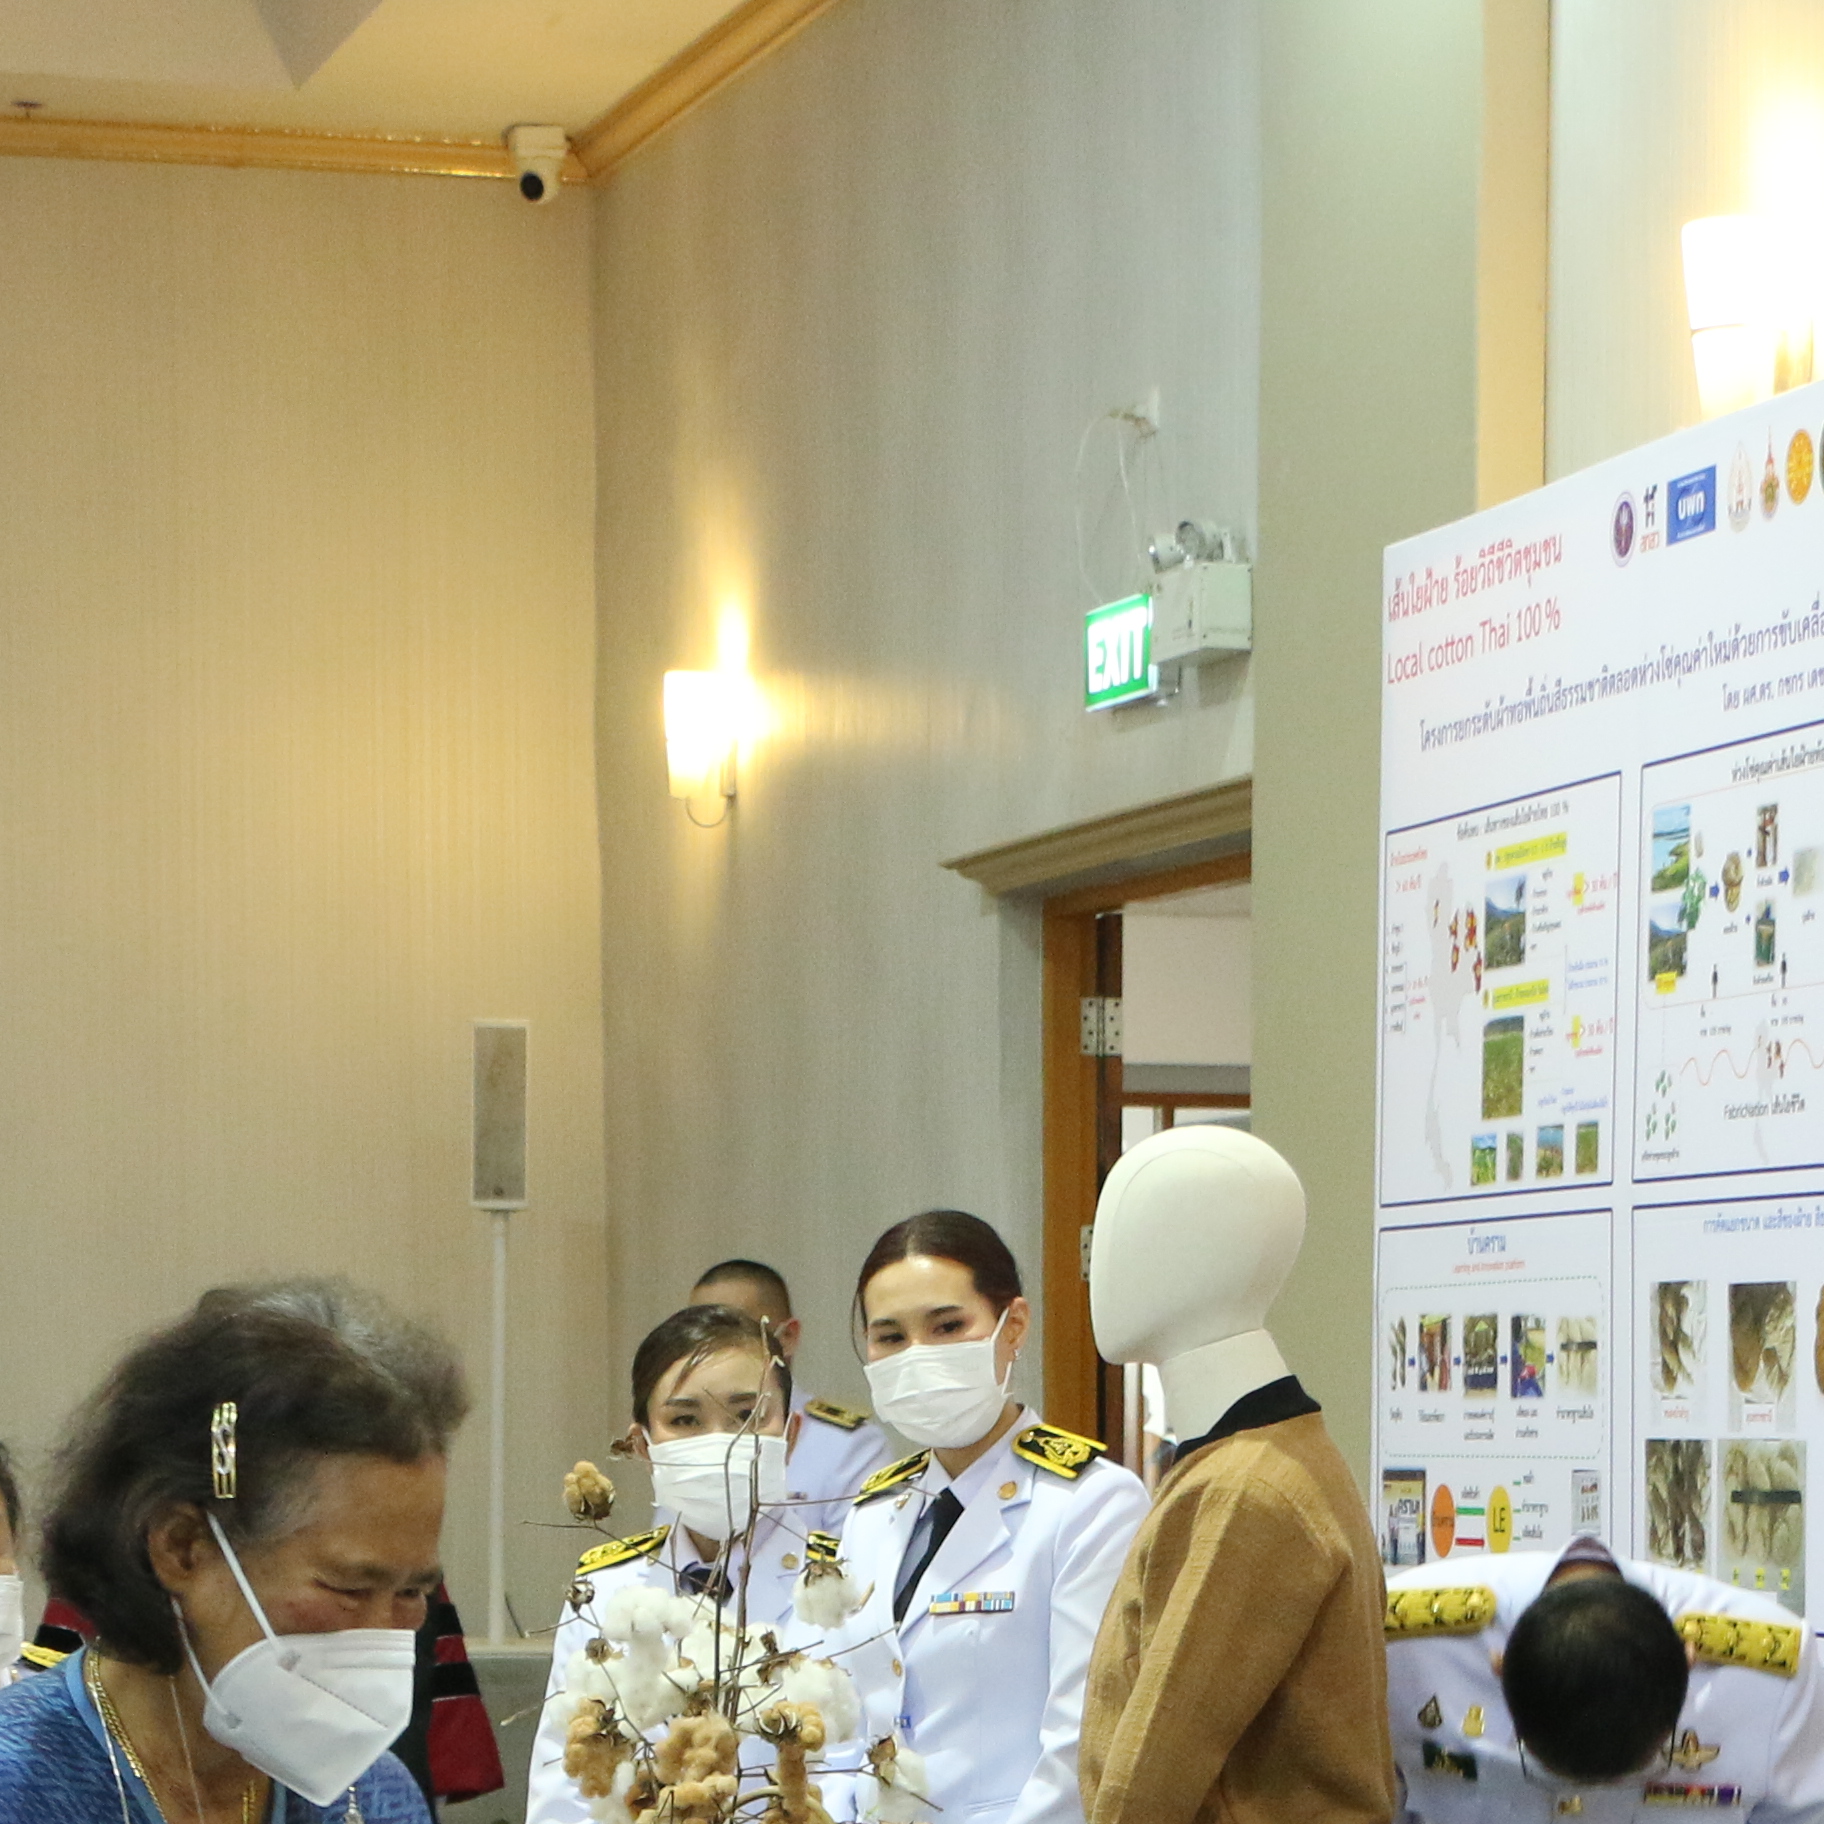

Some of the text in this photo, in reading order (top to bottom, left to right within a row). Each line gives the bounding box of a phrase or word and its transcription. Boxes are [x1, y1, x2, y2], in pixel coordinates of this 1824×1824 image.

[1388, 533, 1563, 622] เส้นใยฝ้าย ร้อยวิถีชีวิตชุมชน
[1087, 606, 1148, 694] EXIT
[1387, 641, 1424, 684] Local
[1427, 634, 1474, 672] cotton
[1479, 612, 1511, 654] Thai
[1516, 602, 1542, 643] 100
[1722, 682, 1740, 711] โดย
[1493, 1506, 1506, 1534] LE
